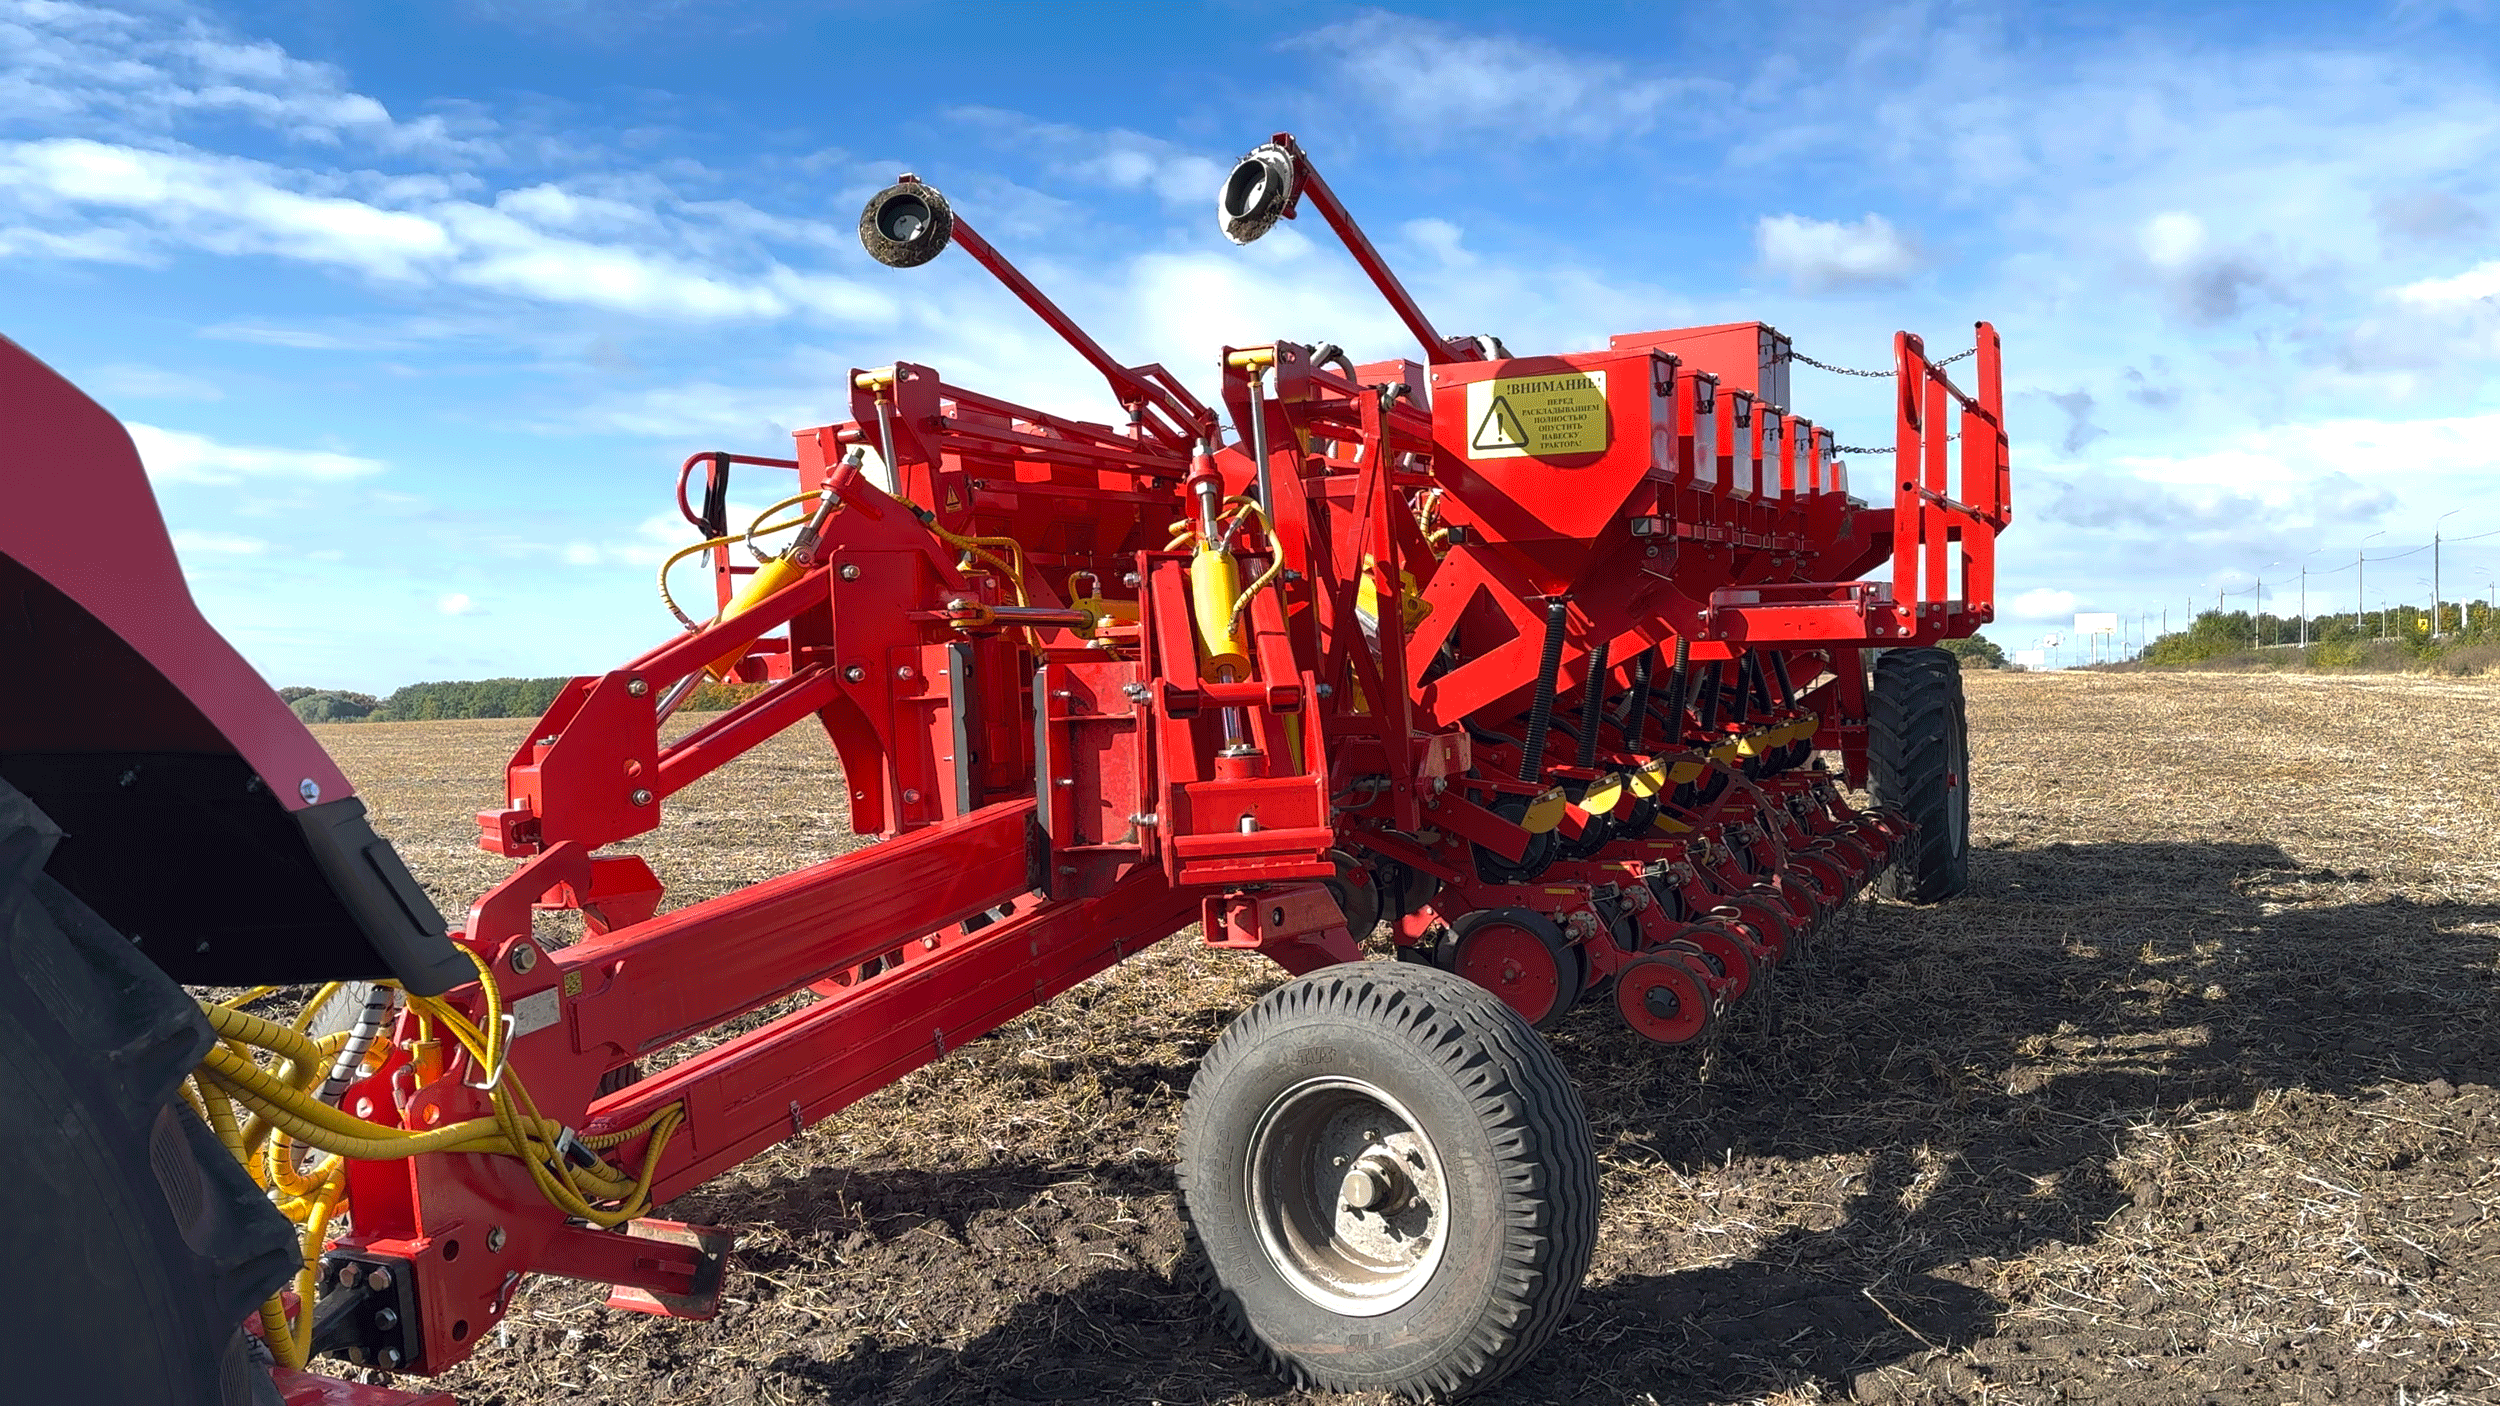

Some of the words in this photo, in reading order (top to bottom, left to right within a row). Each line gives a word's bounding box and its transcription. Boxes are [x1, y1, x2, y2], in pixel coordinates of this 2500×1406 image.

[1522, 404, 1599, 416] РАСКЛАДЫВАНИЕМ
[1534, 414, 1587, 423] ПОЛНОСТЬЮ
[1538, 423, 1582, 432] ОПУСТИТЬ
[1541, 432, 1579, 440] НАВЕСКУ
[1540, 440, 1582, 449] ТРАКТОРА!
